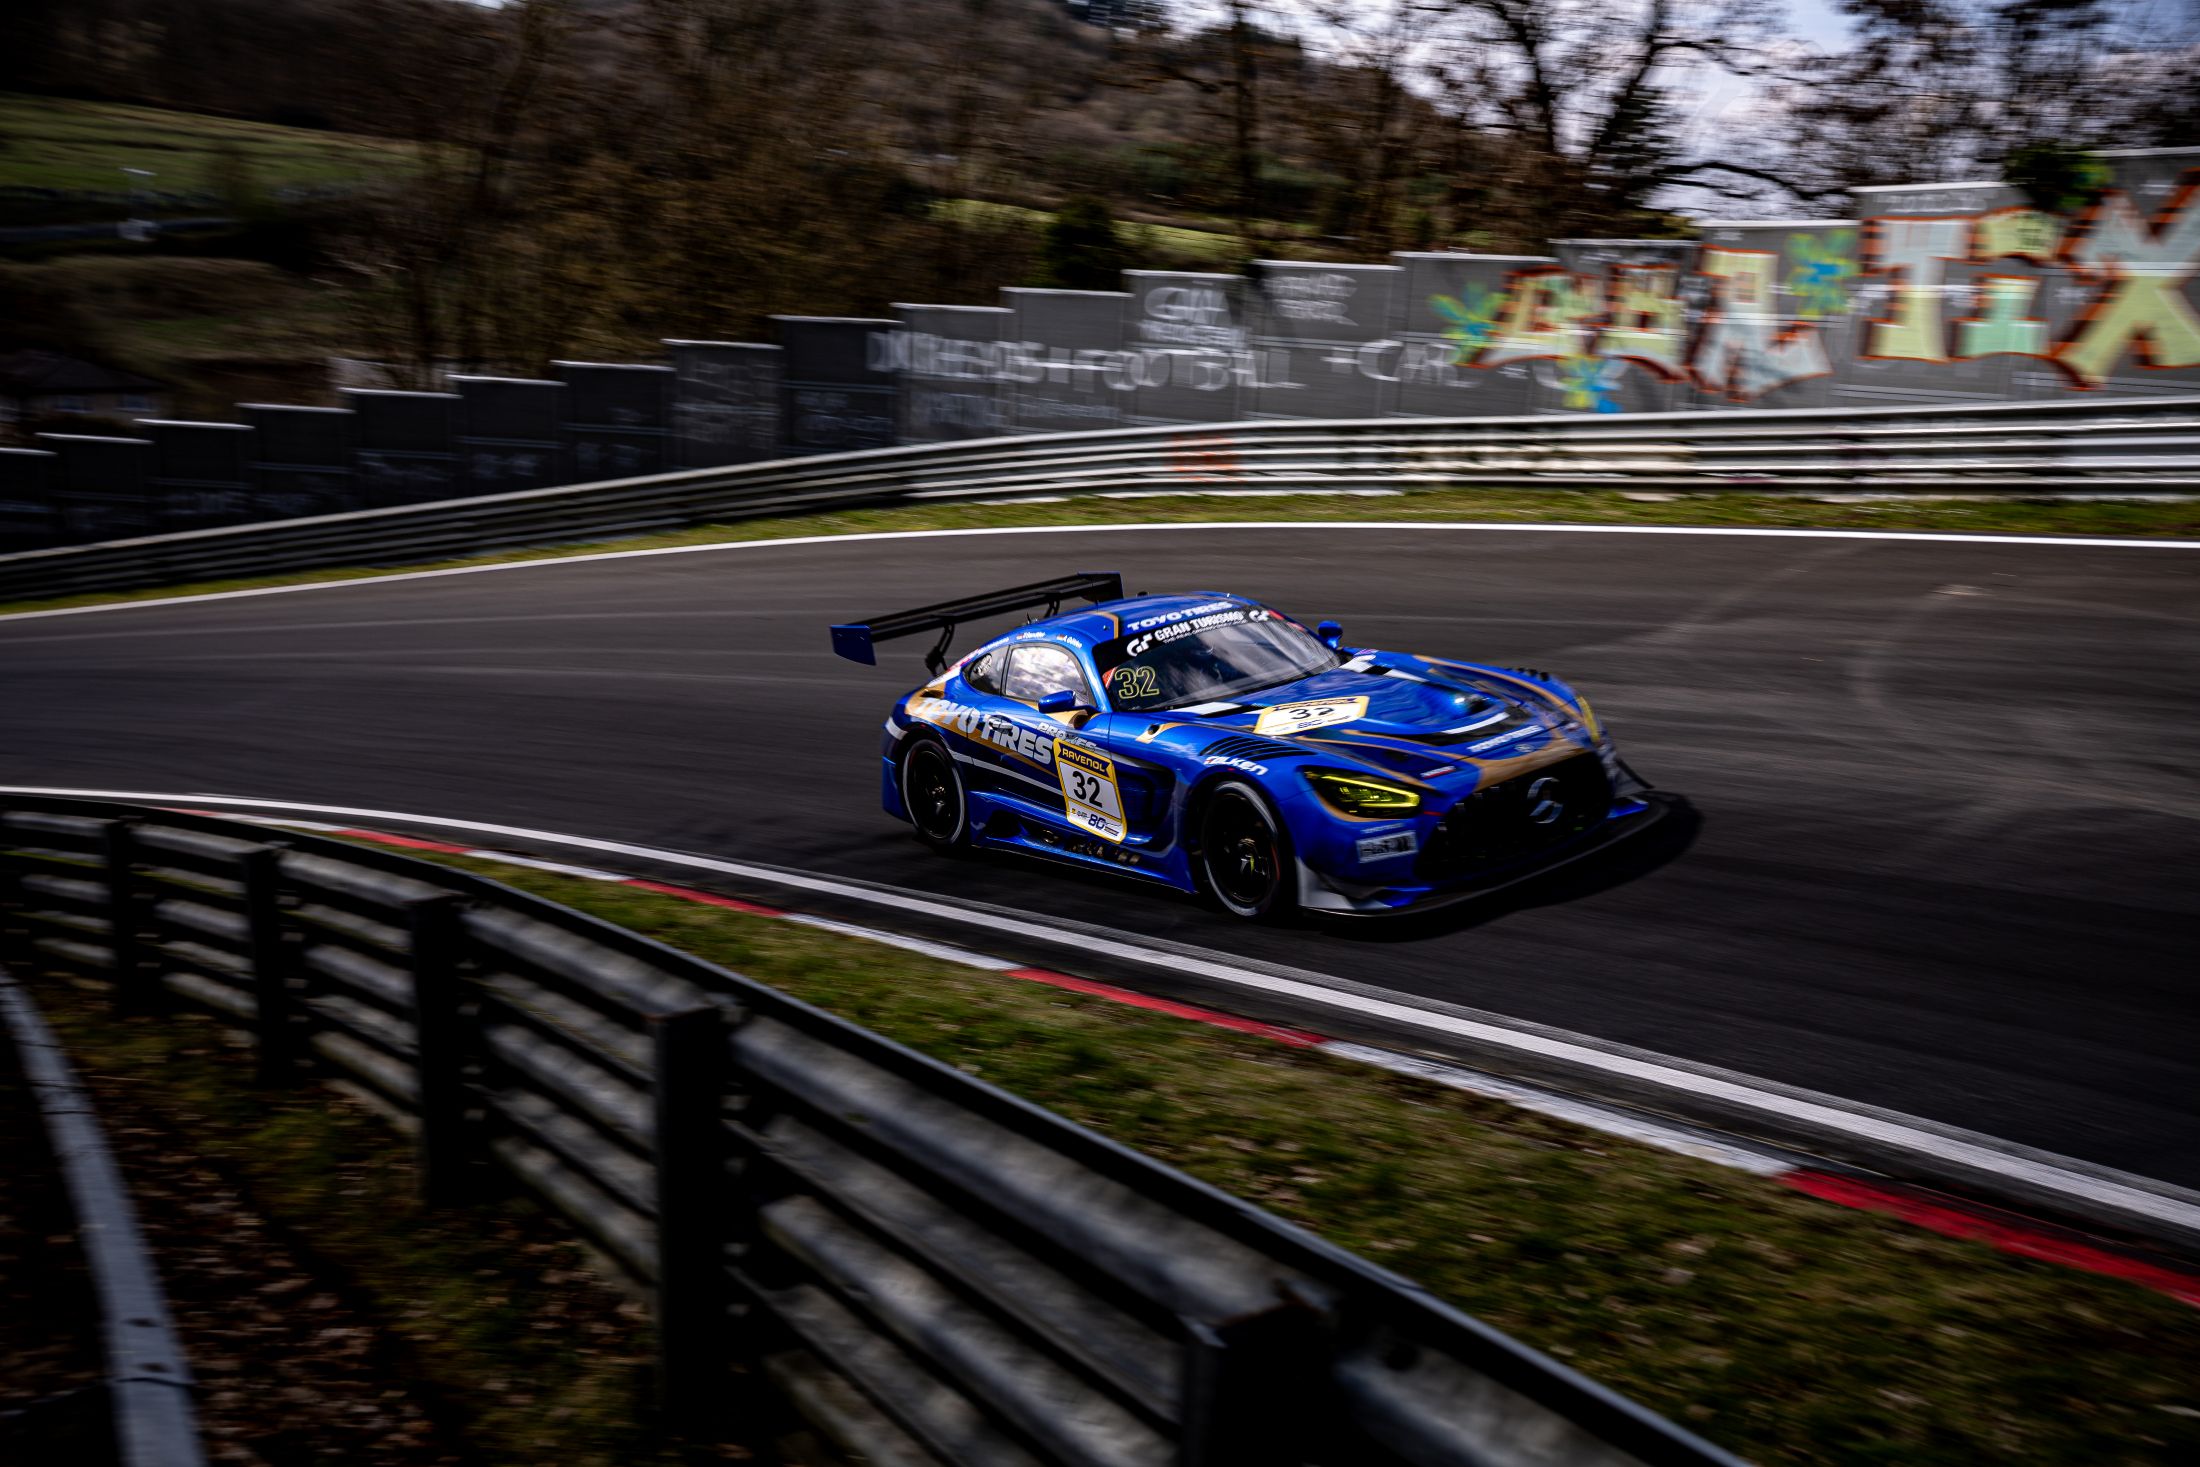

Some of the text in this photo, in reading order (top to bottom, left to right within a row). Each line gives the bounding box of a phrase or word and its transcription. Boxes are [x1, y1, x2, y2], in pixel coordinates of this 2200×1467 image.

[1127, 612, 1182, 631] TOYO
[1154, 621, 1192, 642] GRAN
[1189, 610, 1245, 630] TURISMO
[1114, 666, 1160, 700] 32
[981, 713, 1053, 765] TIRES
[1061, 747, 1106, 773] RAVENOL
[1072, 770, 1103, 809] 32
